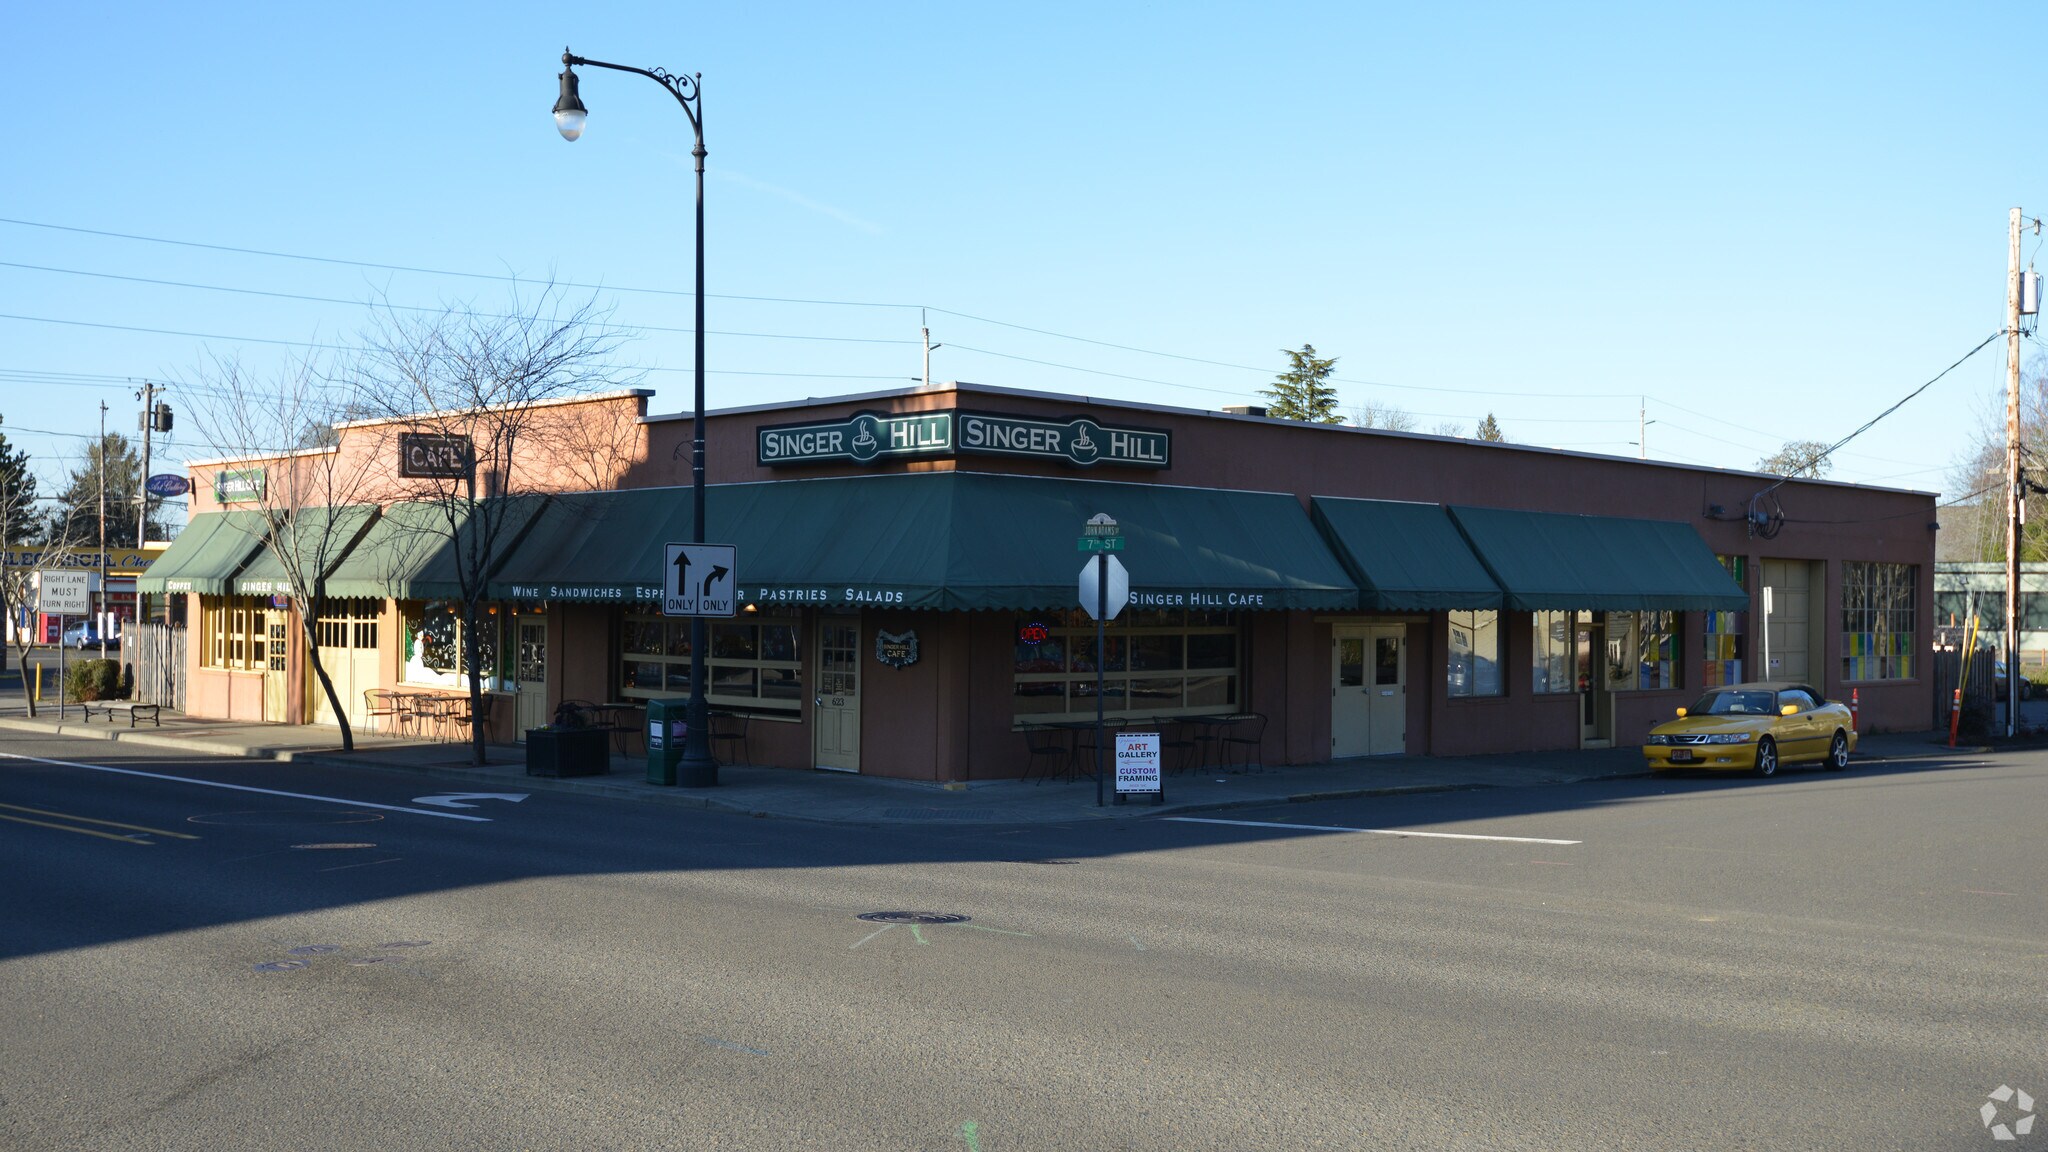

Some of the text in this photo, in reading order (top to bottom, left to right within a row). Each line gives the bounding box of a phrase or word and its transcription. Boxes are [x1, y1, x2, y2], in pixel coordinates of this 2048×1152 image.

[765, 422, 946, 457] SINGER HILL
[966, 419, 1163, 460] SINGER HILL
[1105, 539, 1116, 549] ST
[0, 551, 116, 567] LECRICAL
[44, 575, 86, 584] RIGHT LANE
[51, 588, 77, 596] MUST
[242, 582, 290, 592] SINGER HIL
[512, 586, 539, 597] WINE
[550, 586, 622, 598] SANDWICHES
[760, 588, 903, 602] PASTRIES SALADS
[1129, 591, 1263, 605] SINGER HILL CAFE
[42, 600, 86, 609] TURN RIGHT
[668, 599, 694, 610] ONLY
[703, 600, 728, 611] ONLY
[1020, 627, 1047, 641] OPEN
[887, 650, 906, 658] CAFE
